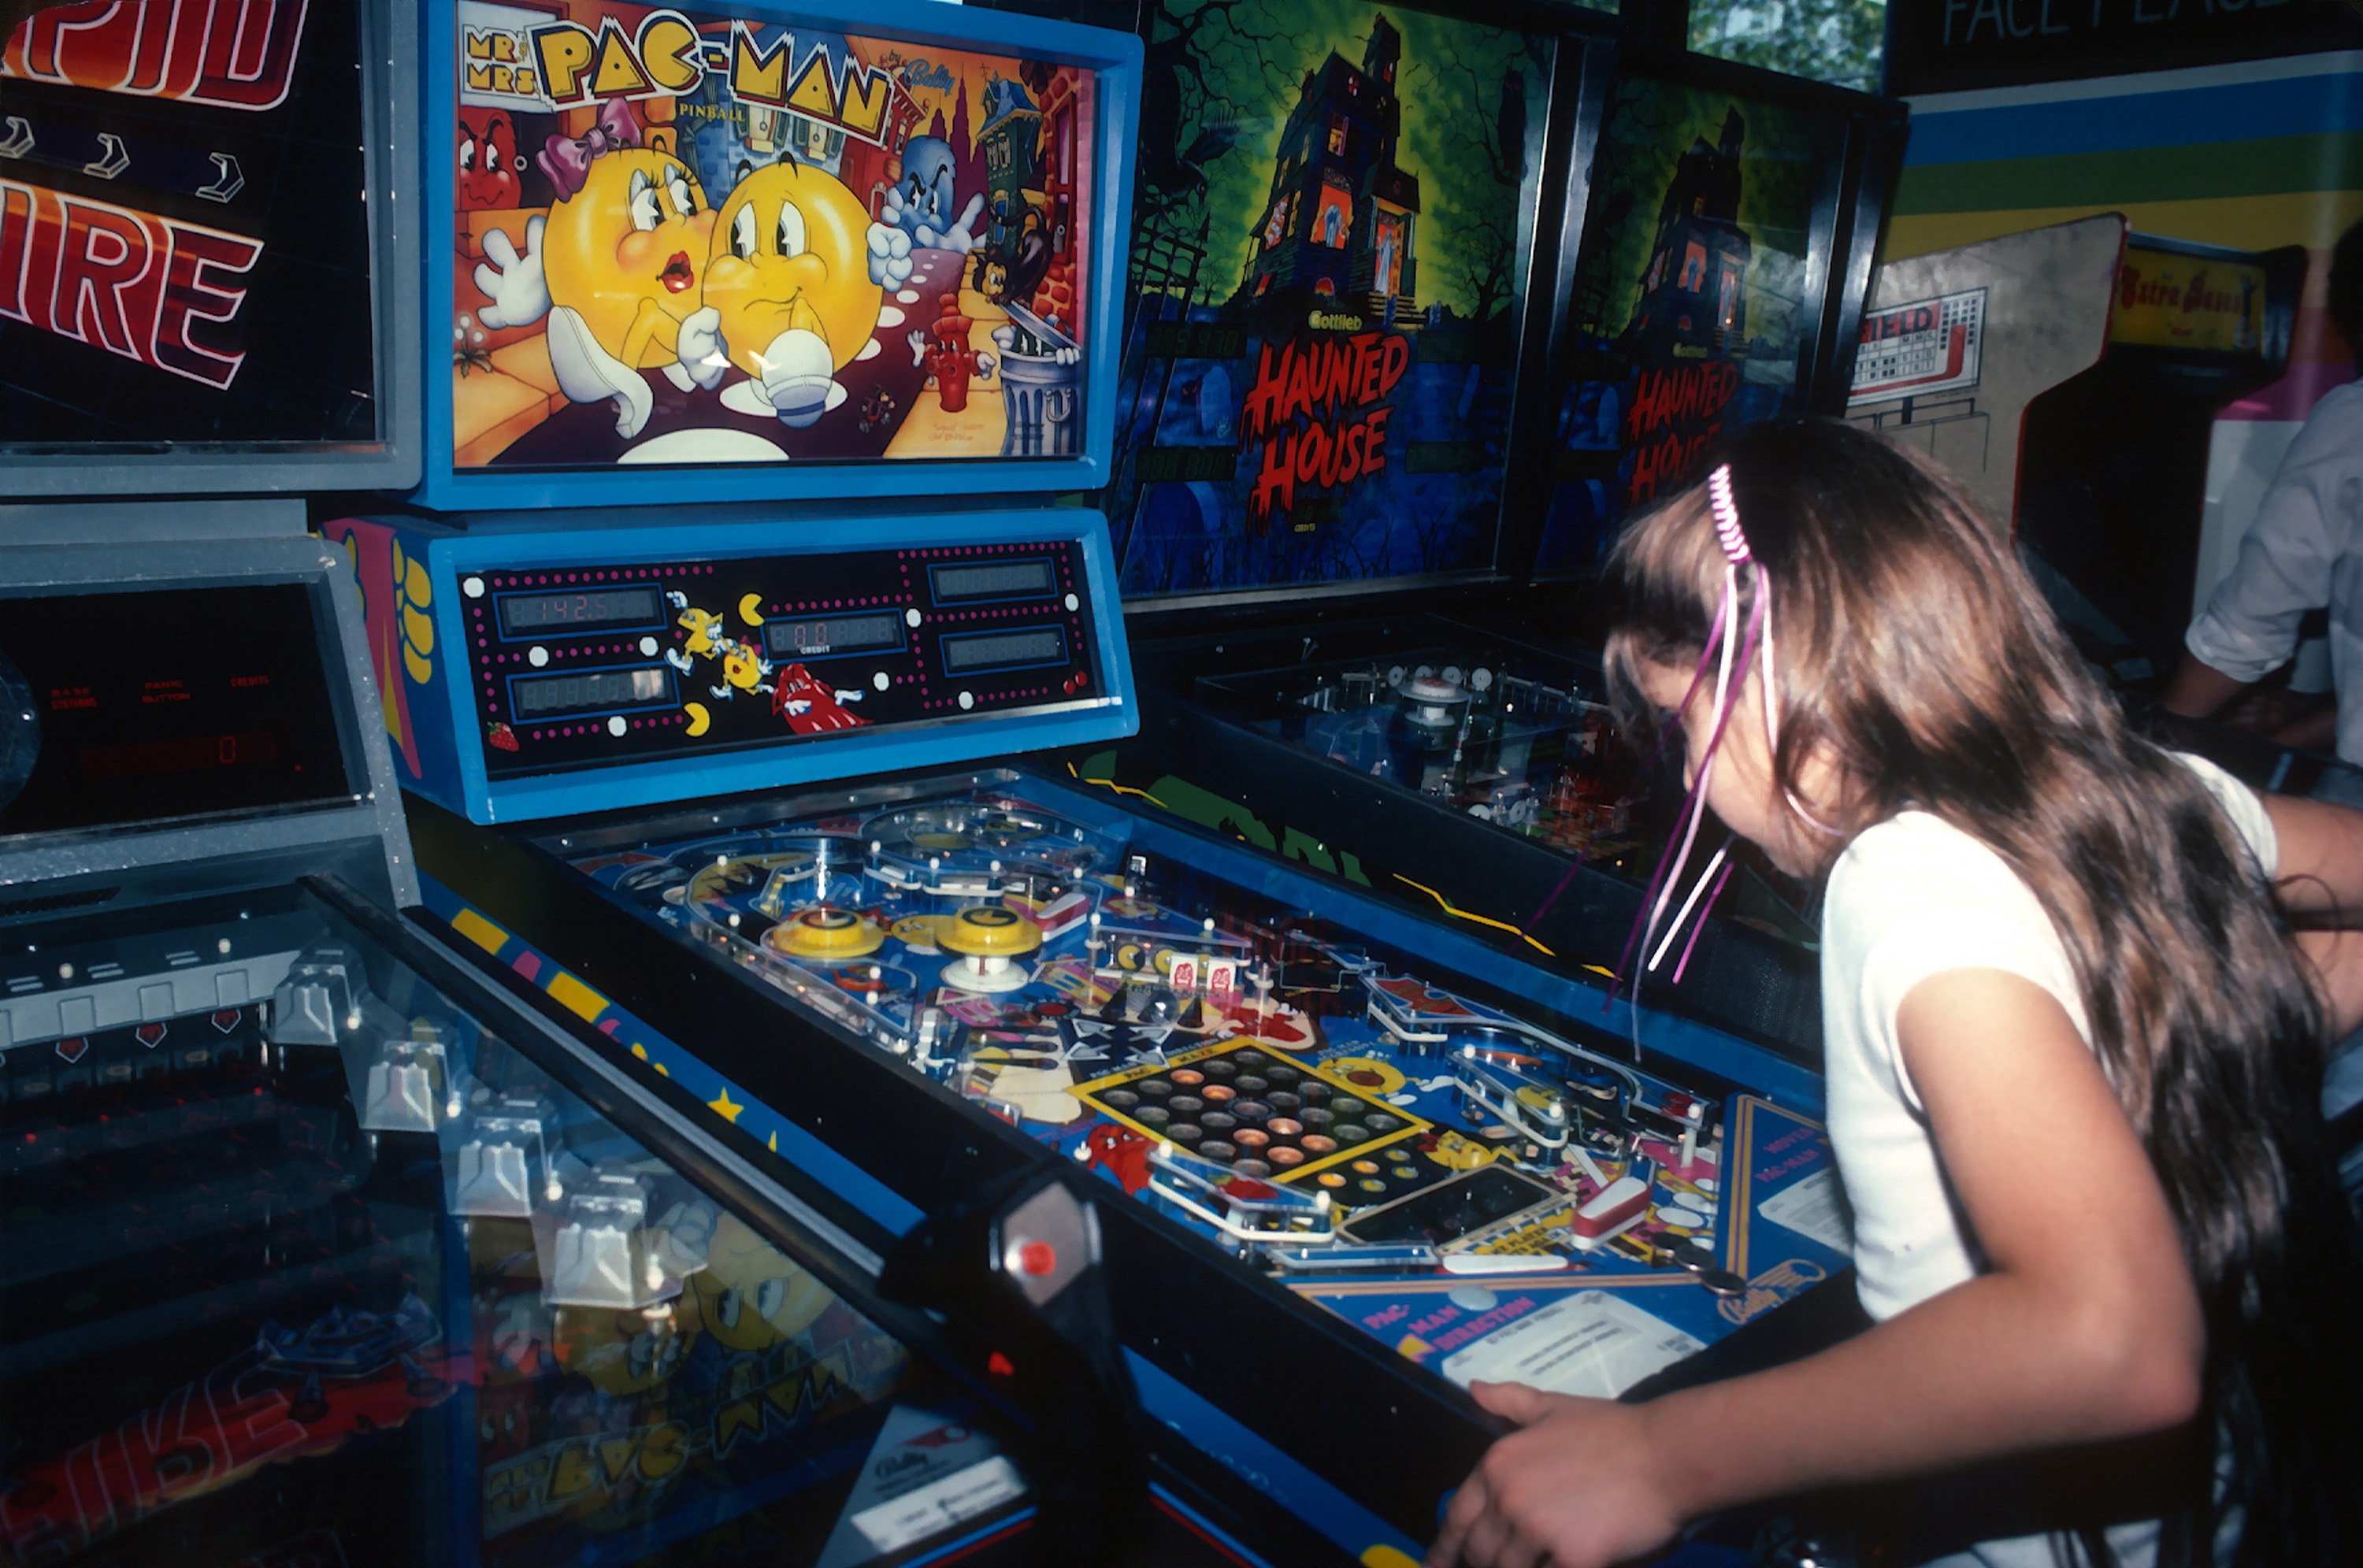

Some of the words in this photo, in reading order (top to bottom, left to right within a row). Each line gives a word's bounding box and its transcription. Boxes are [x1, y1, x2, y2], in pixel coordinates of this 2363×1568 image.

[525, 9, 896, 147] PAC-MAN
[888, 50, 902, 65] by
[903, 58, 956, 96] Bally
[678, 102, 747, 123] PINBALL
[0, 178, 265, 391] IRE
[1308, 311, 1363, 332] Gottlieb
[1239, 331, 1411, 454] HAUNTED
[1625, 360, 1738, 457] HAUNTED
[1245, 406, 1396, 538] HOUSE
[141, 691, 191, 703] BUTTON
[1407, 1304, 1463, 1336] MAN
[1432, 1296, 1537, 1352] DIRECTION
